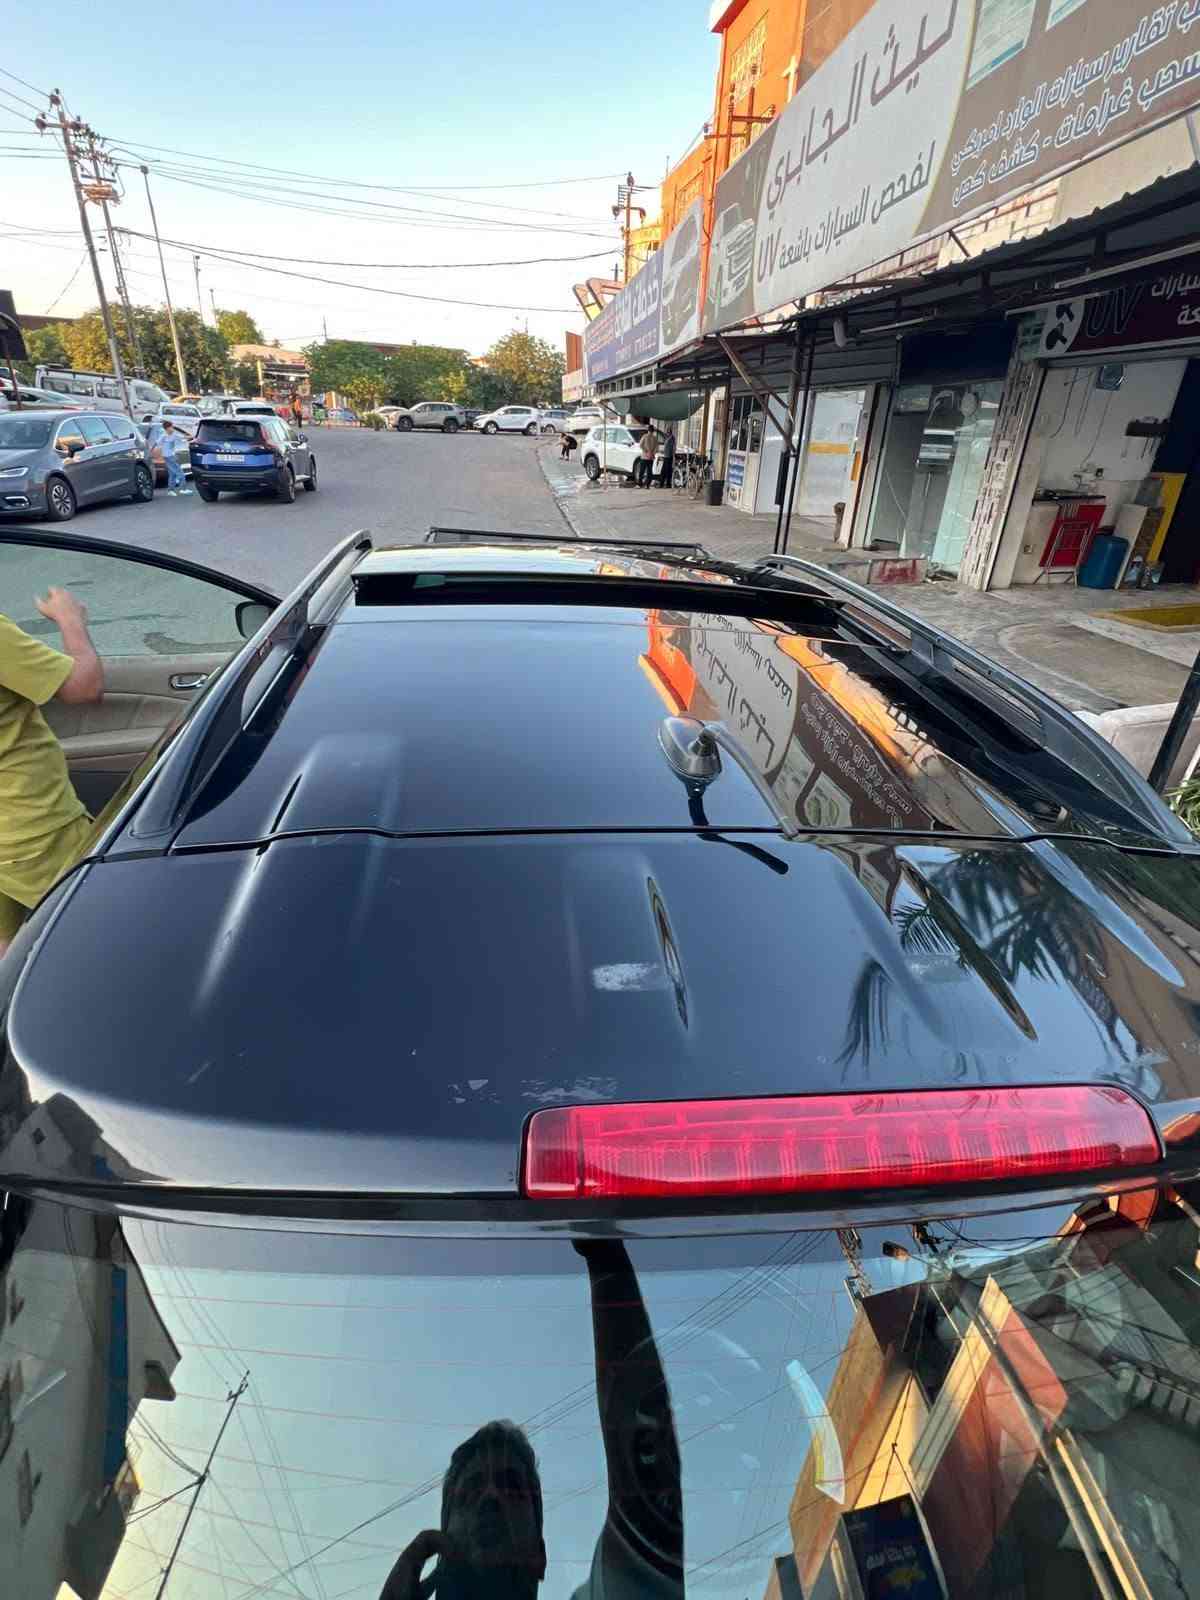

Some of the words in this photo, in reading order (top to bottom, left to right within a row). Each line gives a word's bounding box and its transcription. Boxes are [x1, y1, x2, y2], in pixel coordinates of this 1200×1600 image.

[869, 0, 958, 107] ليث
[766, 52, 868, 221] الجابري
[1055, 77, 1134, 148] غرامات
[871, 139, 937, 225] لفحص
[988, 129, 1041, 183] كشف
[814, 184, 872, 254] السيارات
[757, 227, 782, 283] UV
